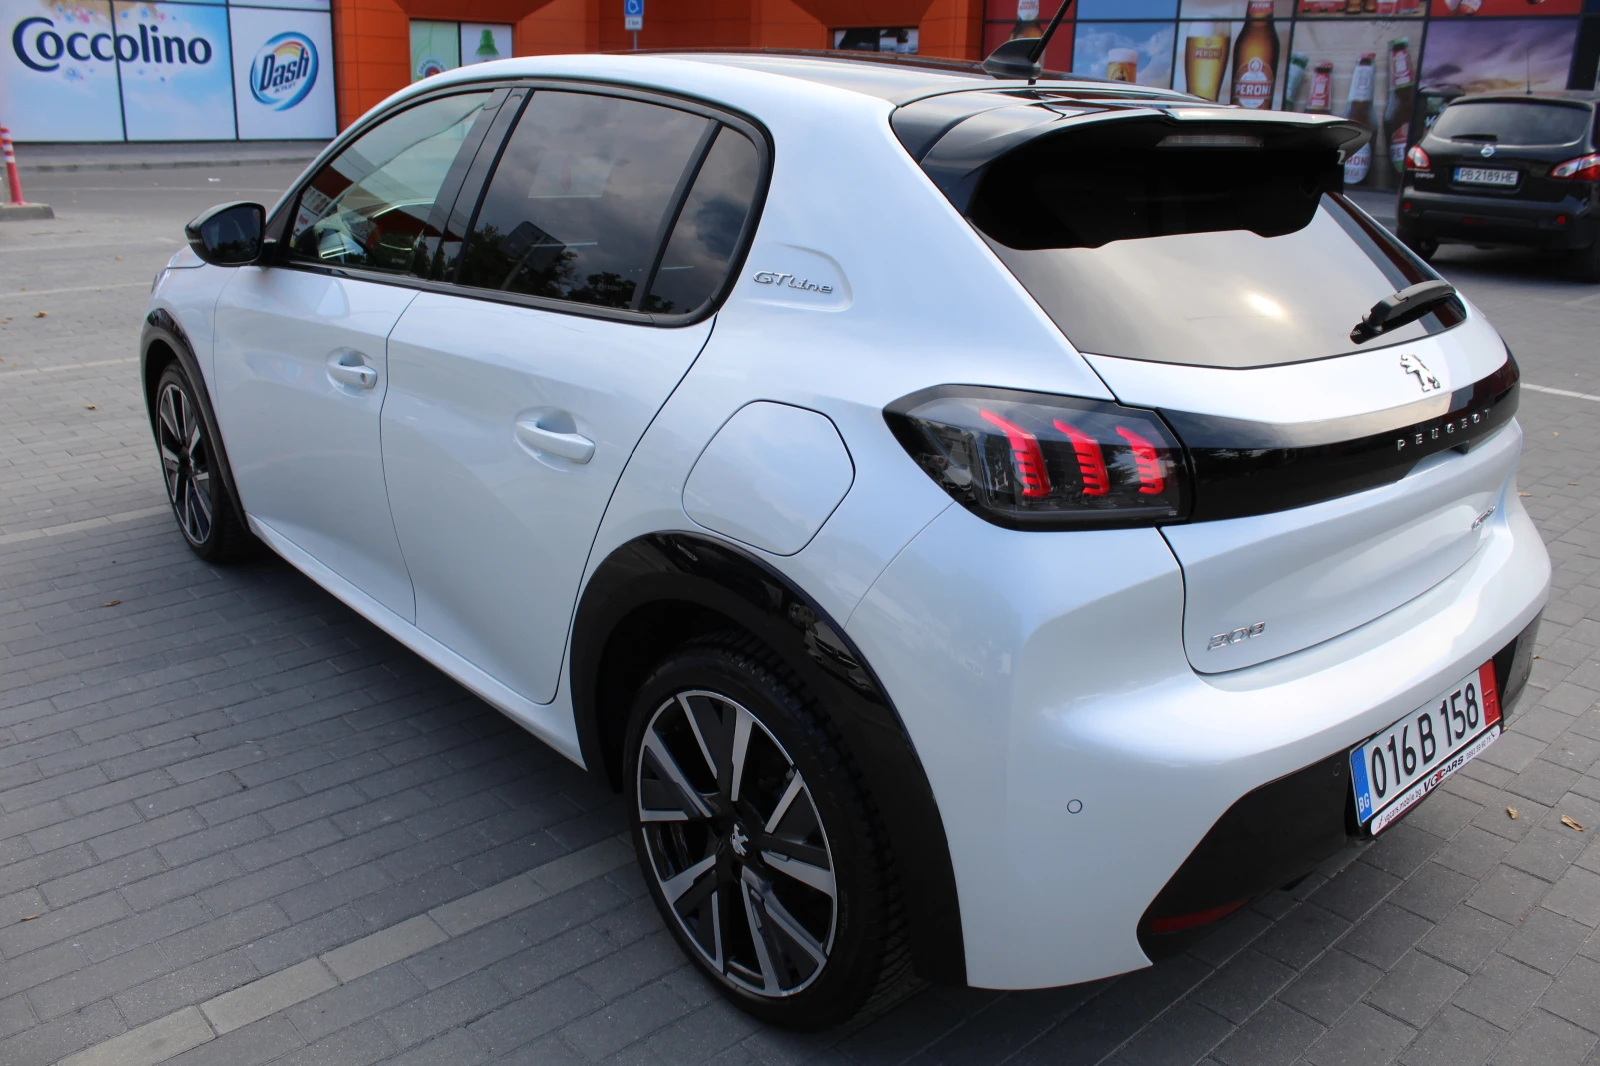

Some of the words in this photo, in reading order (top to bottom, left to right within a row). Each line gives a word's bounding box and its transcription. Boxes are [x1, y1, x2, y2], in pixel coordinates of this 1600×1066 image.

[12, 16, 213, 72] Coccolino
[259, 46, 310, 92] Dash
[1235, 84, 1272, 96] PERONI
[1475, 171, 1500, 182] 2189
[1397, 408, 1491, 451] PEUGEOT
[1207, 621, 1266, 651] 208
[1359, 792, 1370, 813] BG
